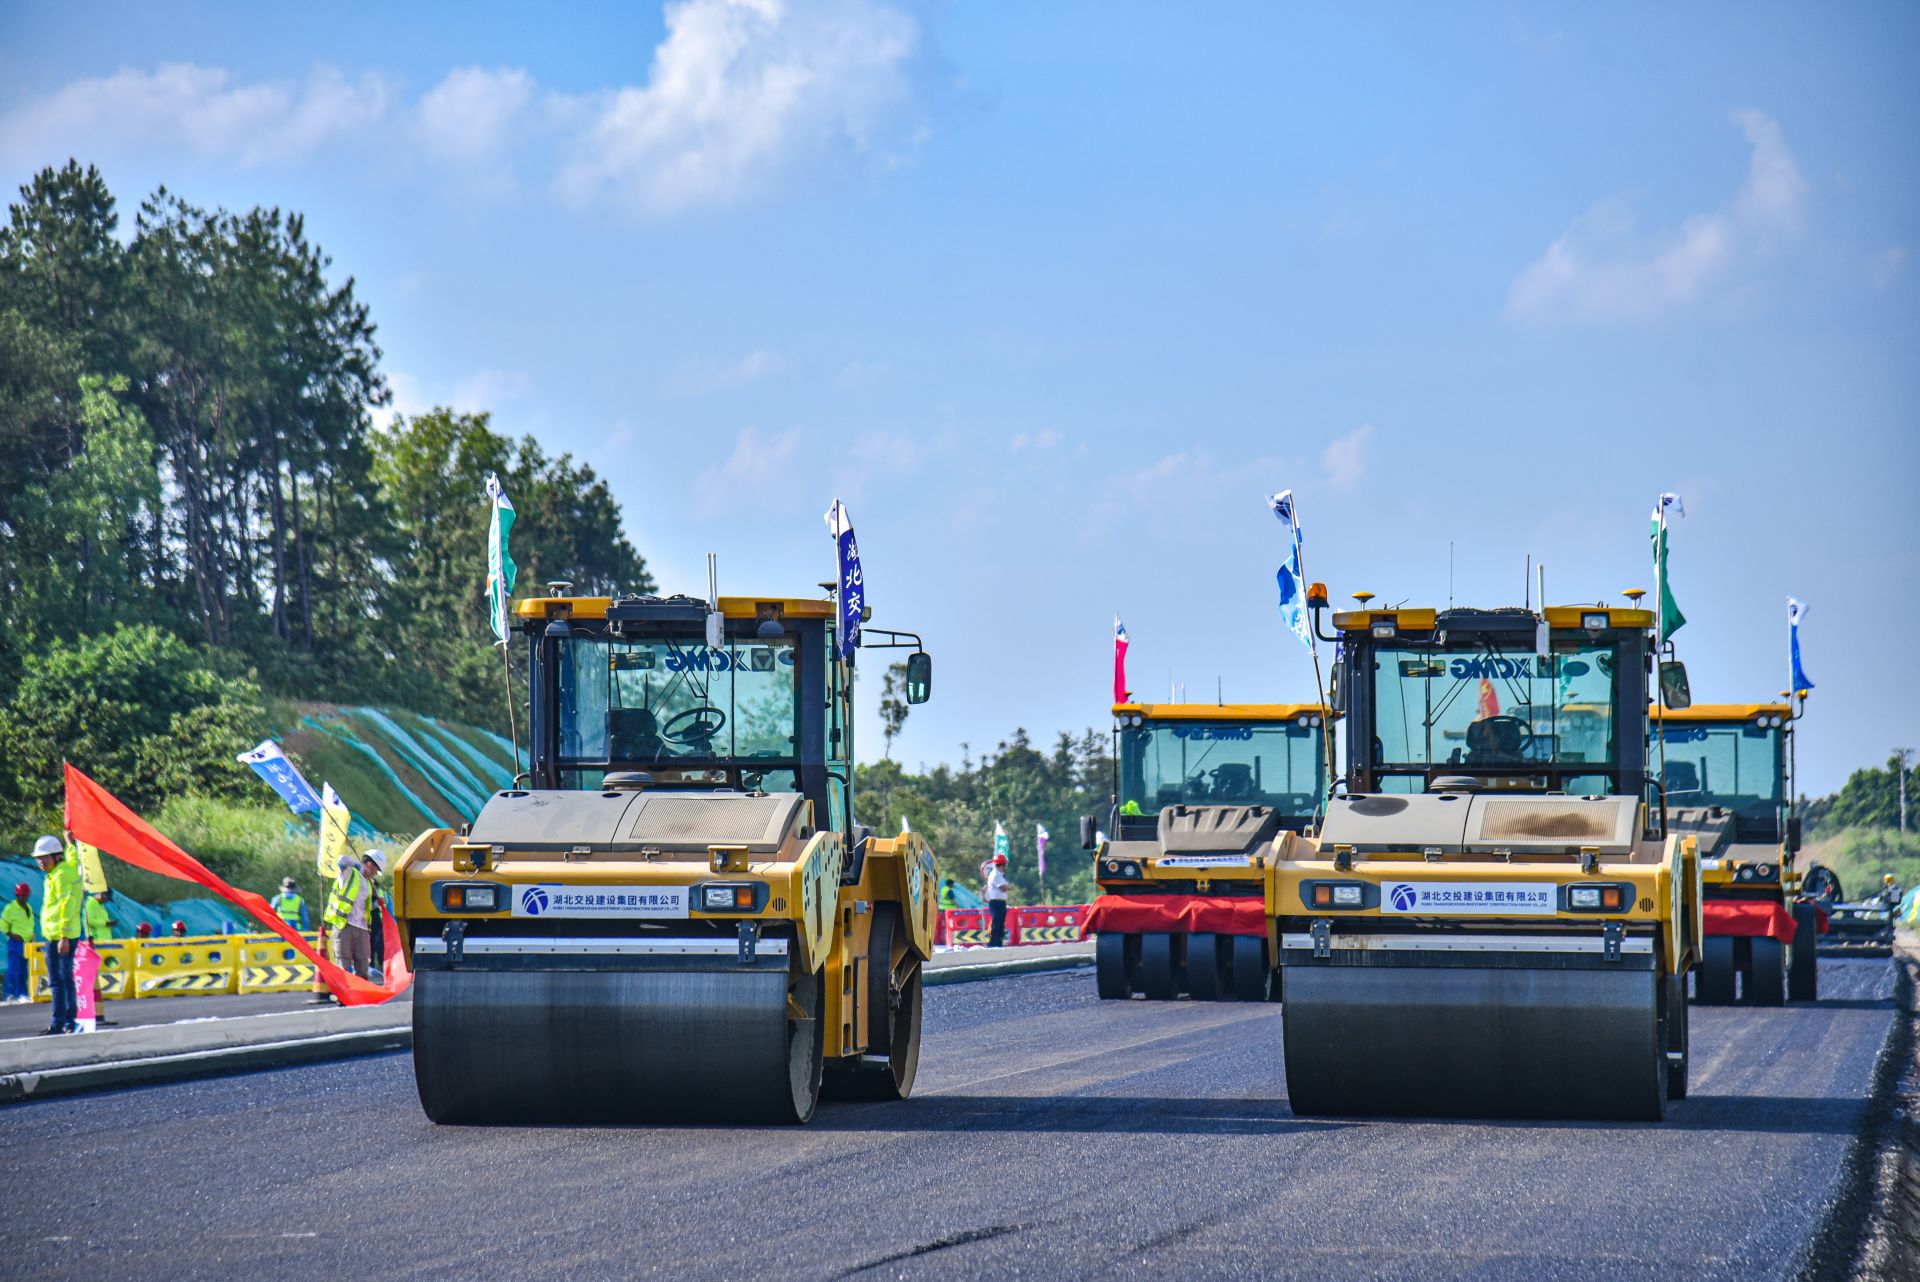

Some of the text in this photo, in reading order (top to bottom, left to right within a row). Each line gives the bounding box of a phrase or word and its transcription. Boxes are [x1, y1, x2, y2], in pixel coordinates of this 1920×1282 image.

[553, 894, 680, 906] 湖北交投建设集团有限公司
[1421, 891, 1548, 902] 湖北交投建设集团有限公司
